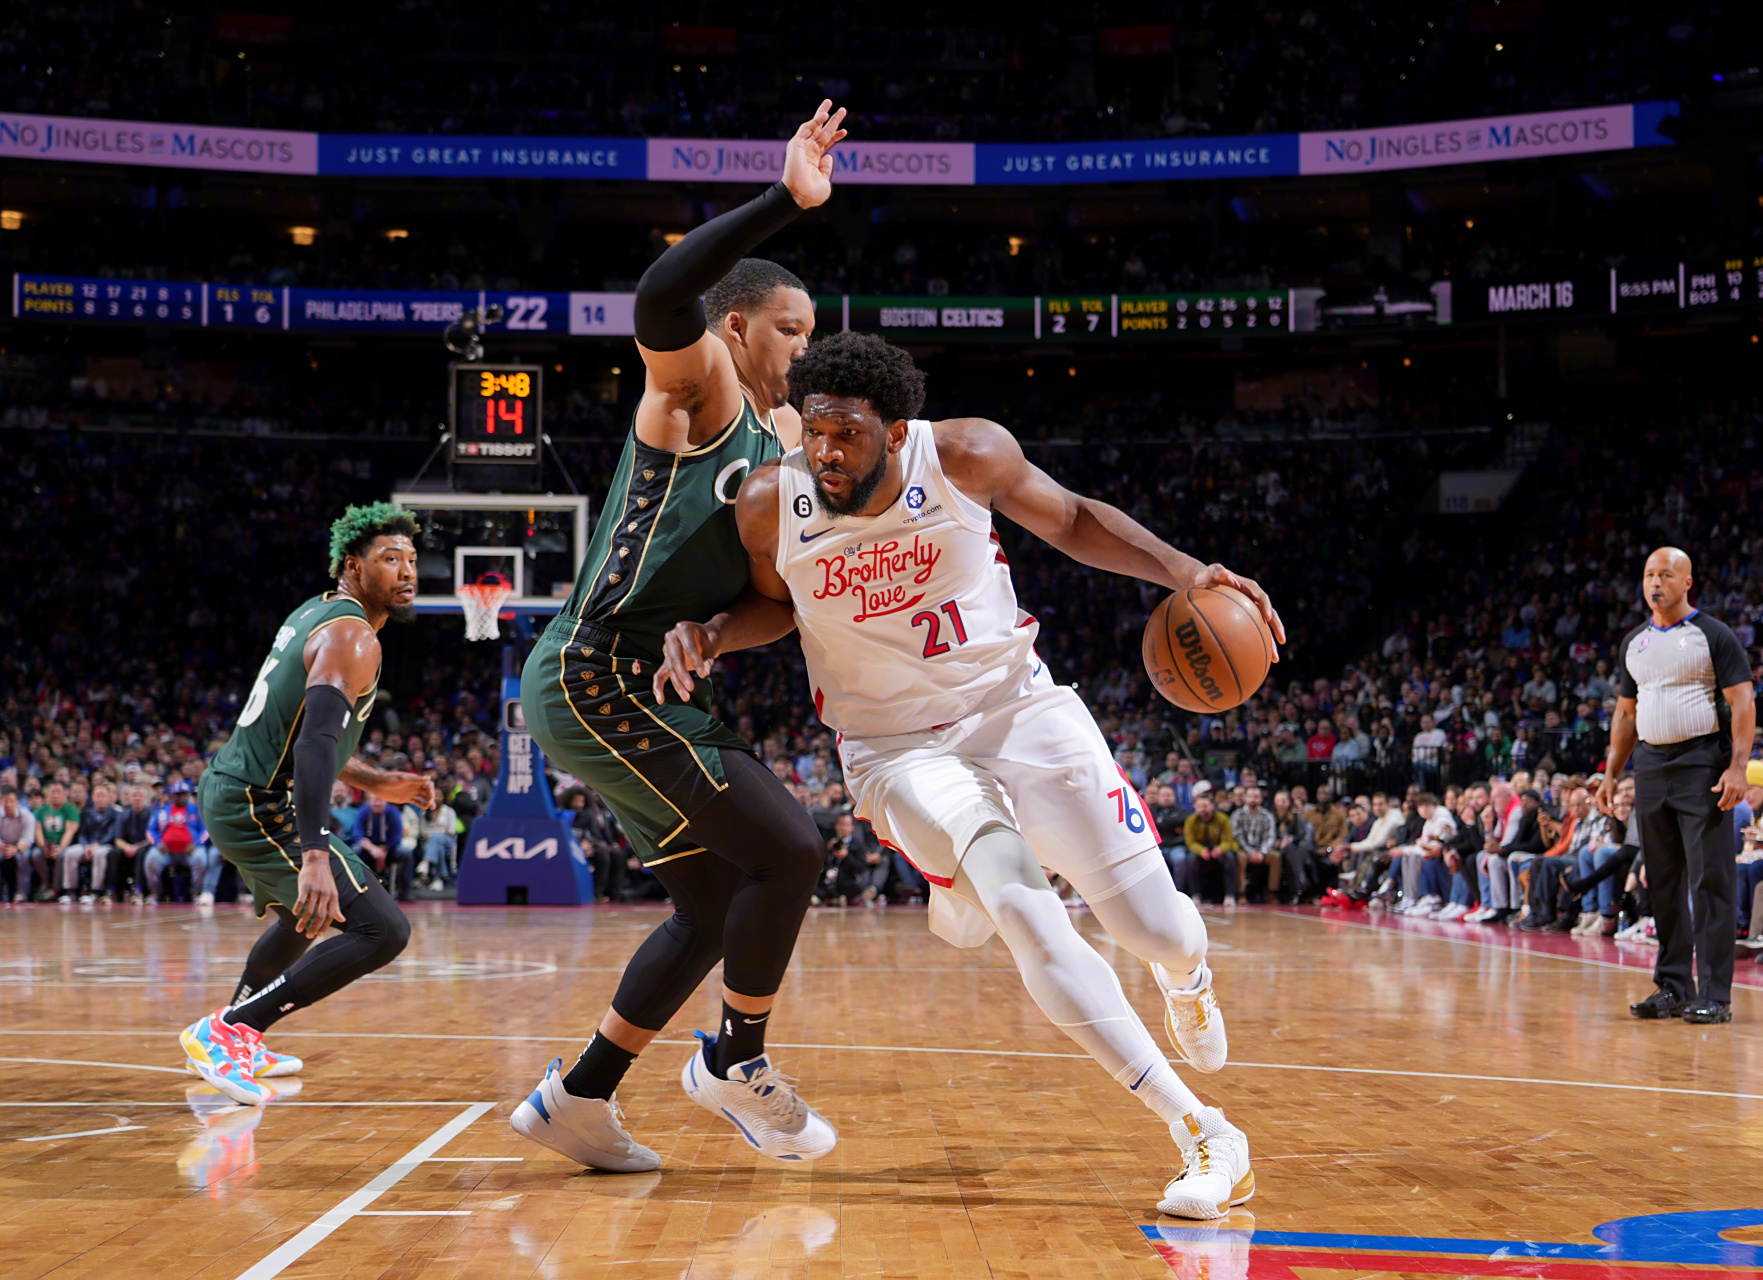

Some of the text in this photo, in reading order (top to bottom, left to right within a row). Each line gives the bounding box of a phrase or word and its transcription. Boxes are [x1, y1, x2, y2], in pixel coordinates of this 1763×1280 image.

[0, 121, 38, 147] NO
[40, 124, 145, 153] JINGLES
[170, 132, 294, 163] MASCOTS
[1324, 138, 1363, 162] NO
[1364, 131, 1463, 166] JINGLES
[1488, 118, 1609, 149] MASCOTS
[346, 147, 620, 167] JUST GREAT INSURANCE
[672, 146, 952, 175] NO JINGL MASCOTS
[1002, 147, 1271, 172] JUST GREAT INSURANCE
[24, 281, 75, 297] PLAYER
[82, 283, 98, 299] 12
[107, 284, 122, 299] 17
[1652, 278, 1676, 295] PM
[1691, 272, 1716, 290] PHI
[1726, 270, 1743, 286] 10
[216, 287, 240, 302] FLS
[1488, 280, 1574, 313] MARCH 16
[1688, 286, 1740, 306] BOS 4
[24, 298, 74, 314] POINTS
[223, 304, 271, 324] 1 6
[305, 299, 464, 322] PHILADELPHIA 76ERS
[506, 297, 547, 330] 22
[582, 306, 605, 324] 14
[1049, 300, 1071, 314] FLS
[1121, 299, 1169, 314] PLAYER
[880, 307, 1004, 327] BOSTON CELTICS
[1052, 314, 1099, 333] 2 7
[1121, 317, 1169, 331] POINTS
[480, 371, 531, 398] 3:48
[486, 398, 523, 435] 14
[478, 443, 536, 457] TISSOT
[797, 497, 810, 515] 6
[902, 503, 943, 525] crypto.com
[813, 534, 942, 600] Brotherly
[852, 584, 926, 623] Love
[911, 599, 969, 659] 21
[1175, 616, 1224, 702] Wilson
[507, 733, 532, 754] GET
[508, 754, 533, 774] THE
[507, 774, 533, 794] APP
[1107, 786, 1146, 834] 76
[475, 837, 559, 860] KIA
